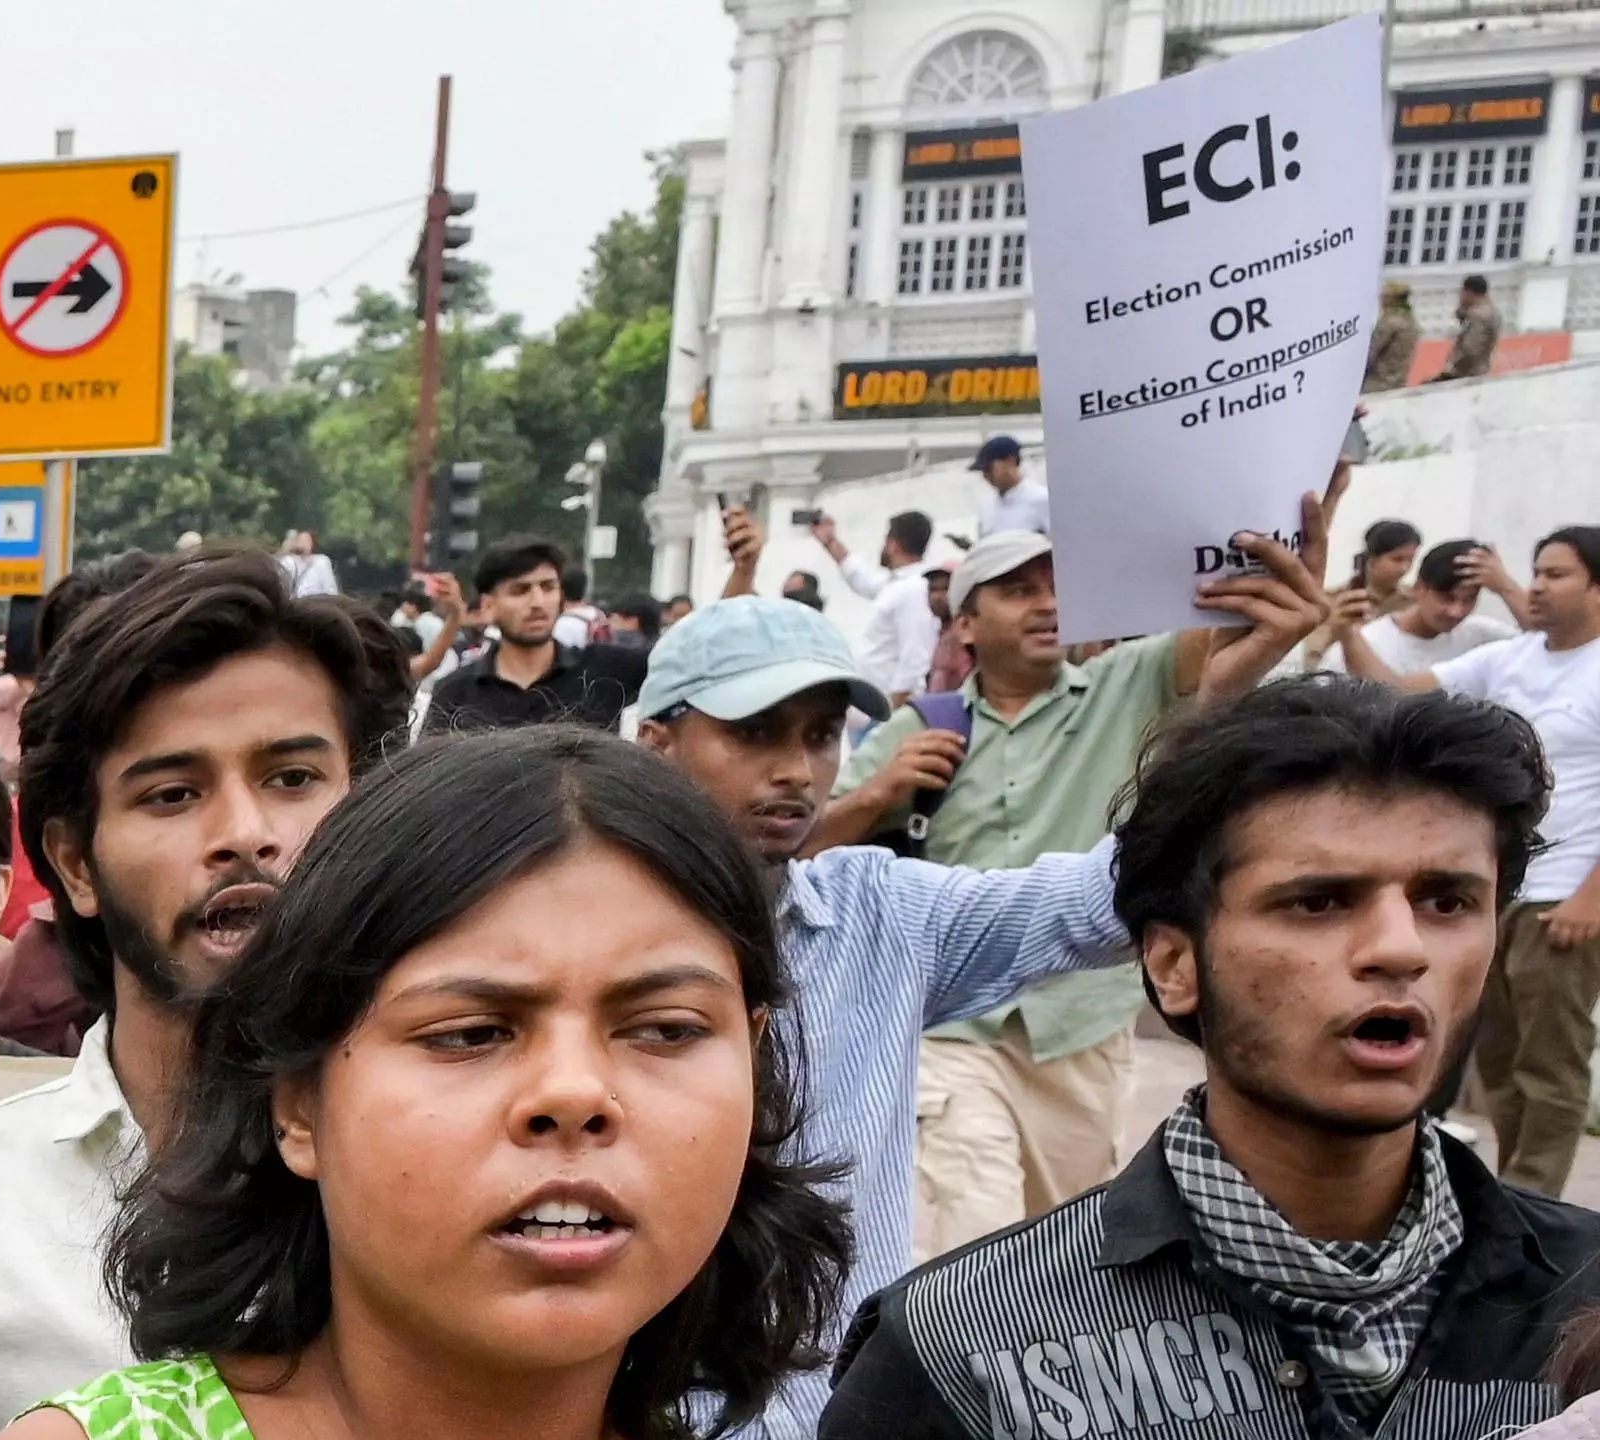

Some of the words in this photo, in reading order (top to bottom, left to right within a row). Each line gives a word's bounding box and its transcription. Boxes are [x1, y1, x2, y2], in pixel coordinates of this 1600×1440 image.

[1142, 114, 1301, 226] ECI:
[1086, 281, 1201, 324] Election
[1209, 225, 1354, 289] Commission
[1209, 297, 1272, 342] OR
[1079, 374, 1198, 418] Election
[1206, 314, 1360, 383] Compromiser
[41, 379, 122, 403] ENTRY
[844, 369, 927, 409] LORD
[1181, 400, 1210, 428] of
[1218, 383, 1287, 419] India
